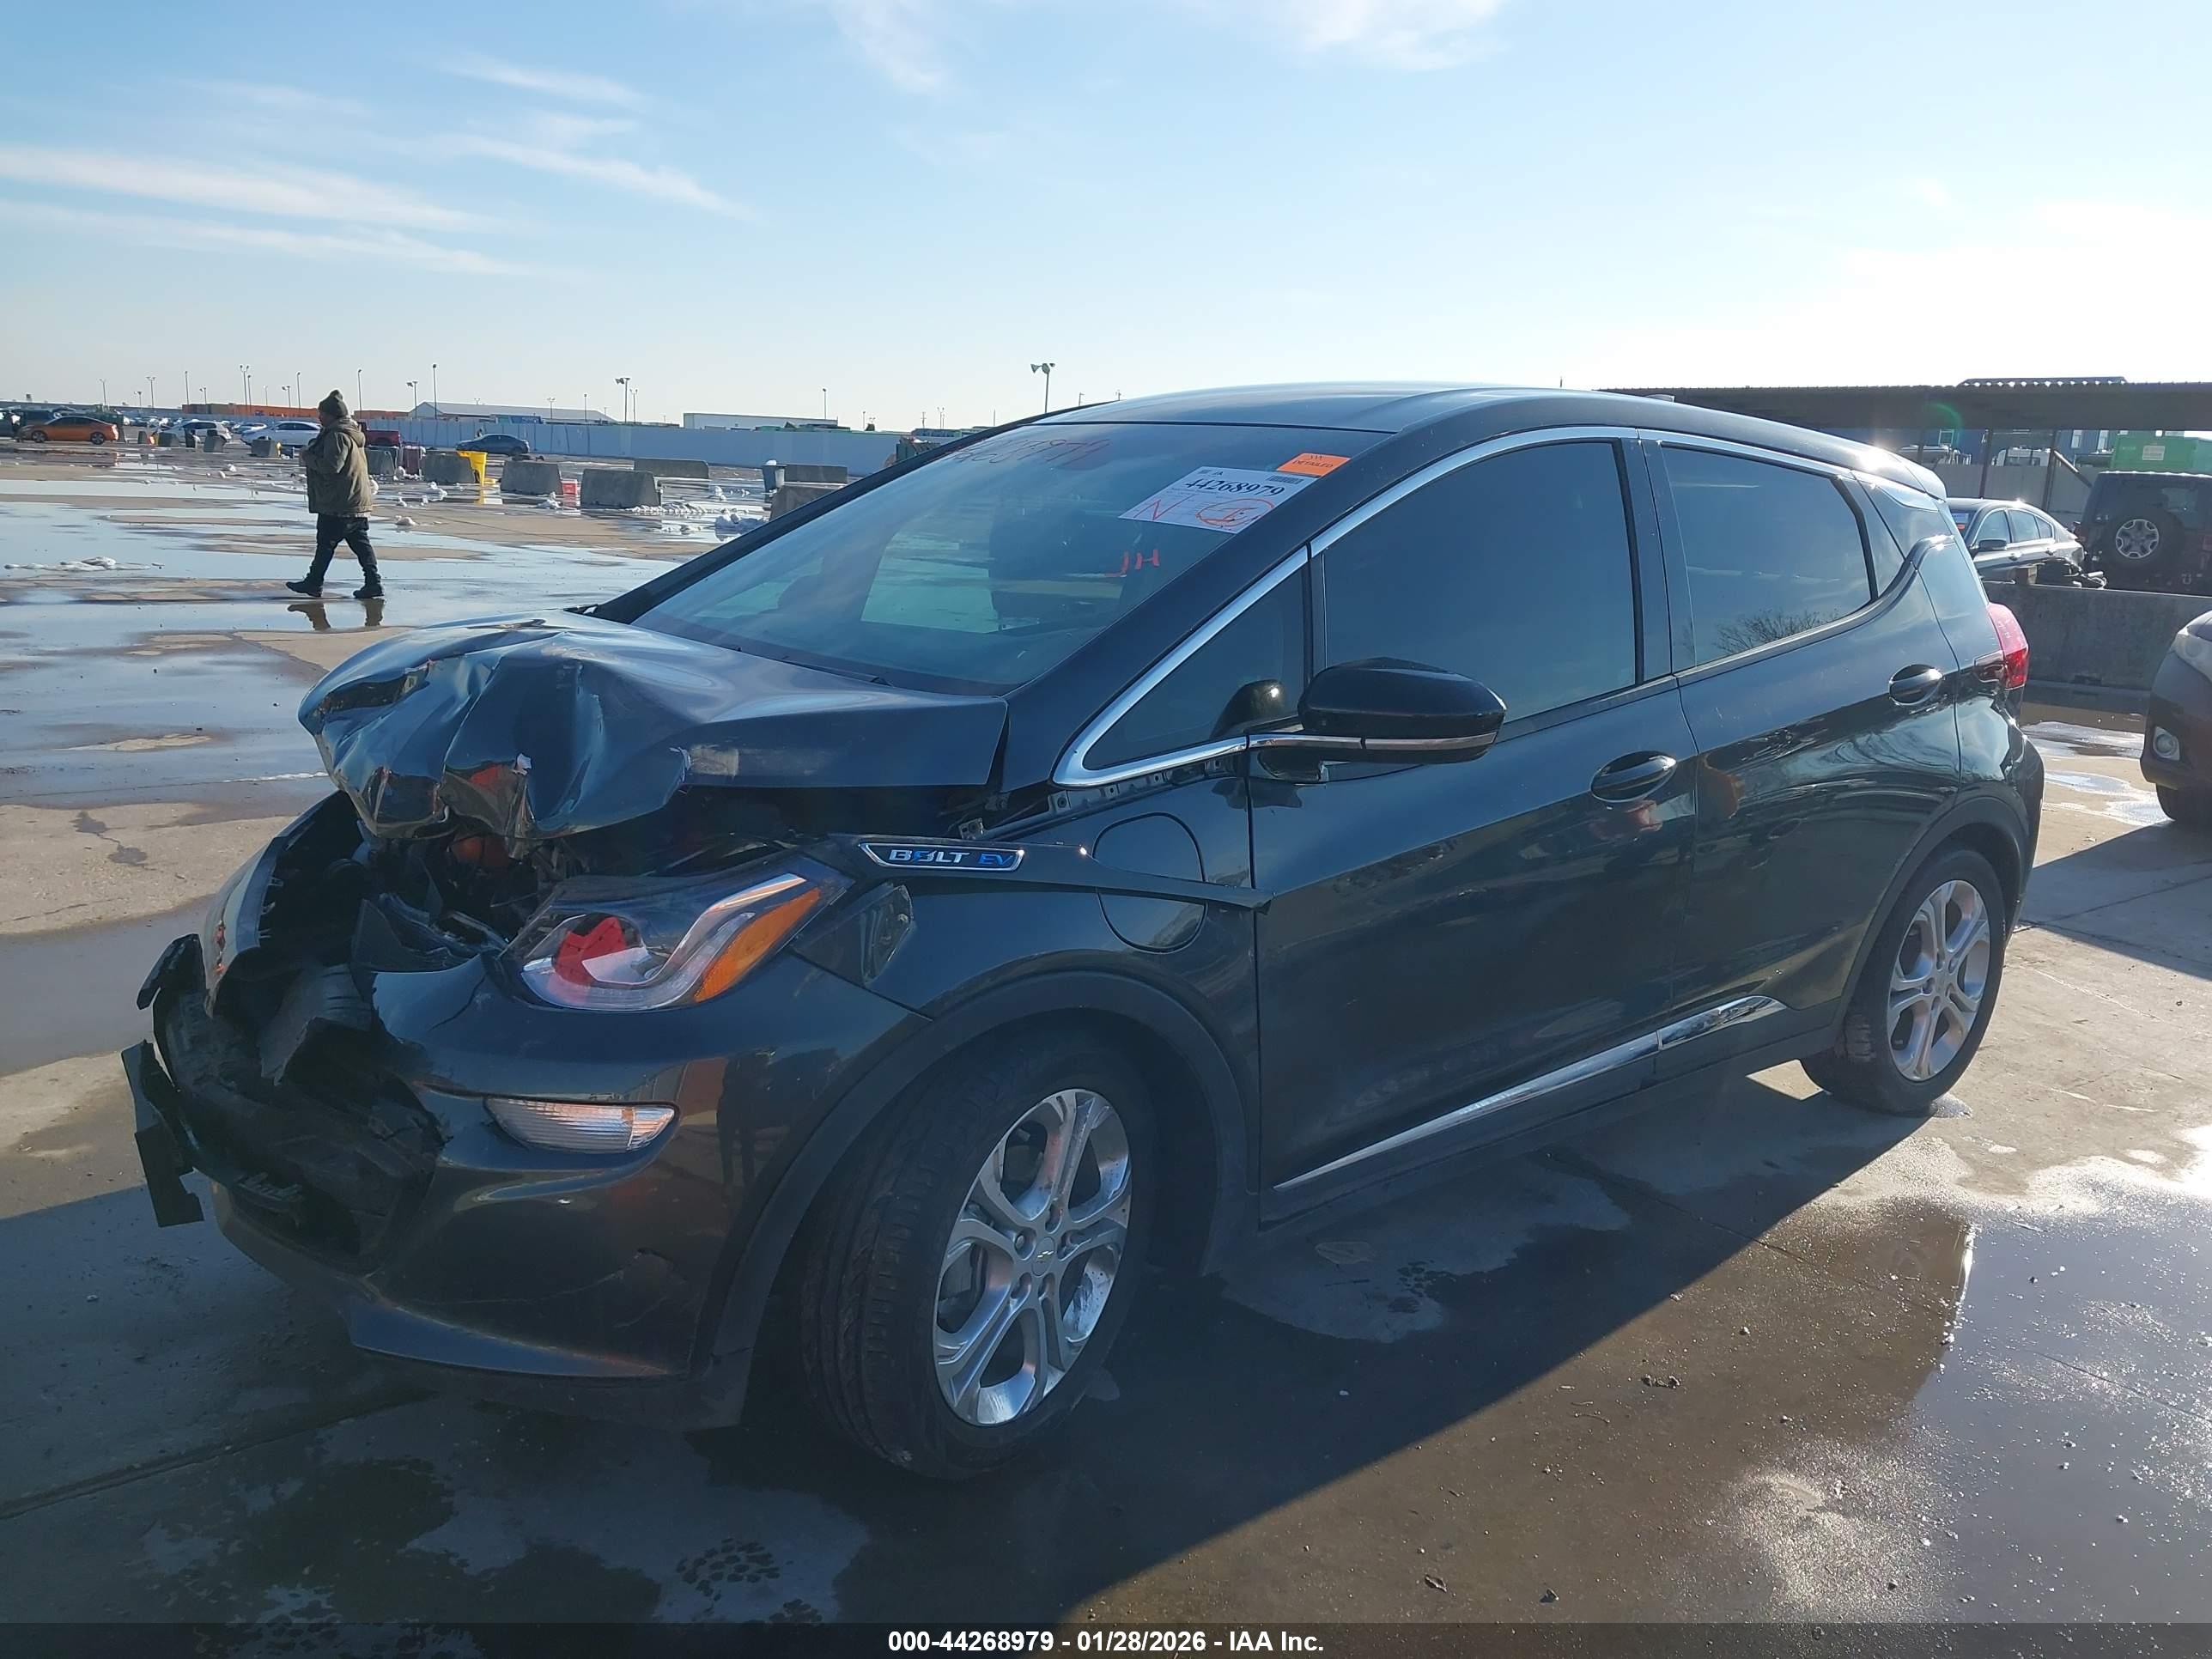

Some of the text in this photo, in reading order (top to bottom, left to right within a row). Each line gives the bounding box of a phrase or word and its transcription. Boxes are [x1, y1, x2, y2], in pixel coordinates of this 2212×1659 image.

[1184, 478, 1285, 497] 44268979
[888, 849, 1014, 866] BOLT EV
